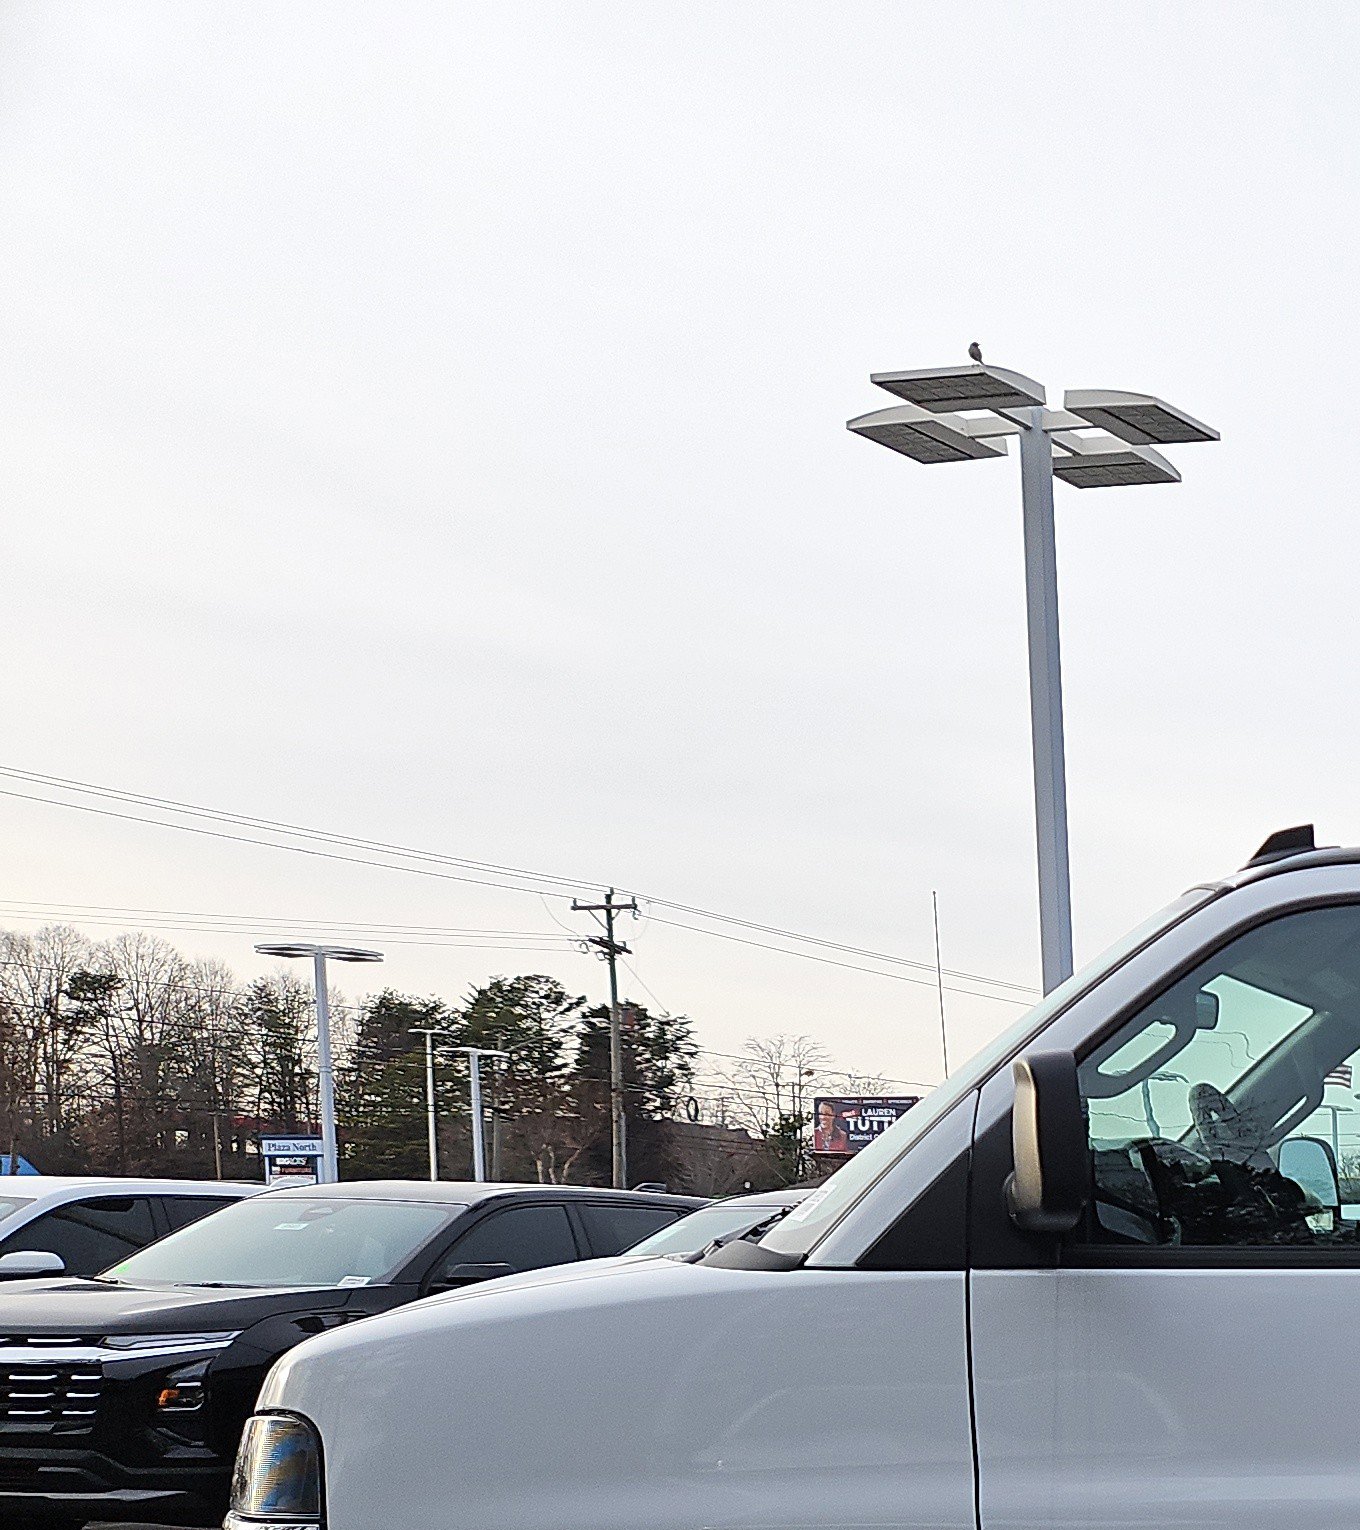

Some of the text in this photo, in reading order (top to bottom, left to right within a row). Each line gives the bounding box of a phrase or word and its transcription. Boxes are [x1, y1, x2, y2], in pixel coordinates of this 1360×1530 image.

[861, 1108, 896, 1116] LAUREN
[267, 1142, 317, 1151] Plaza North
